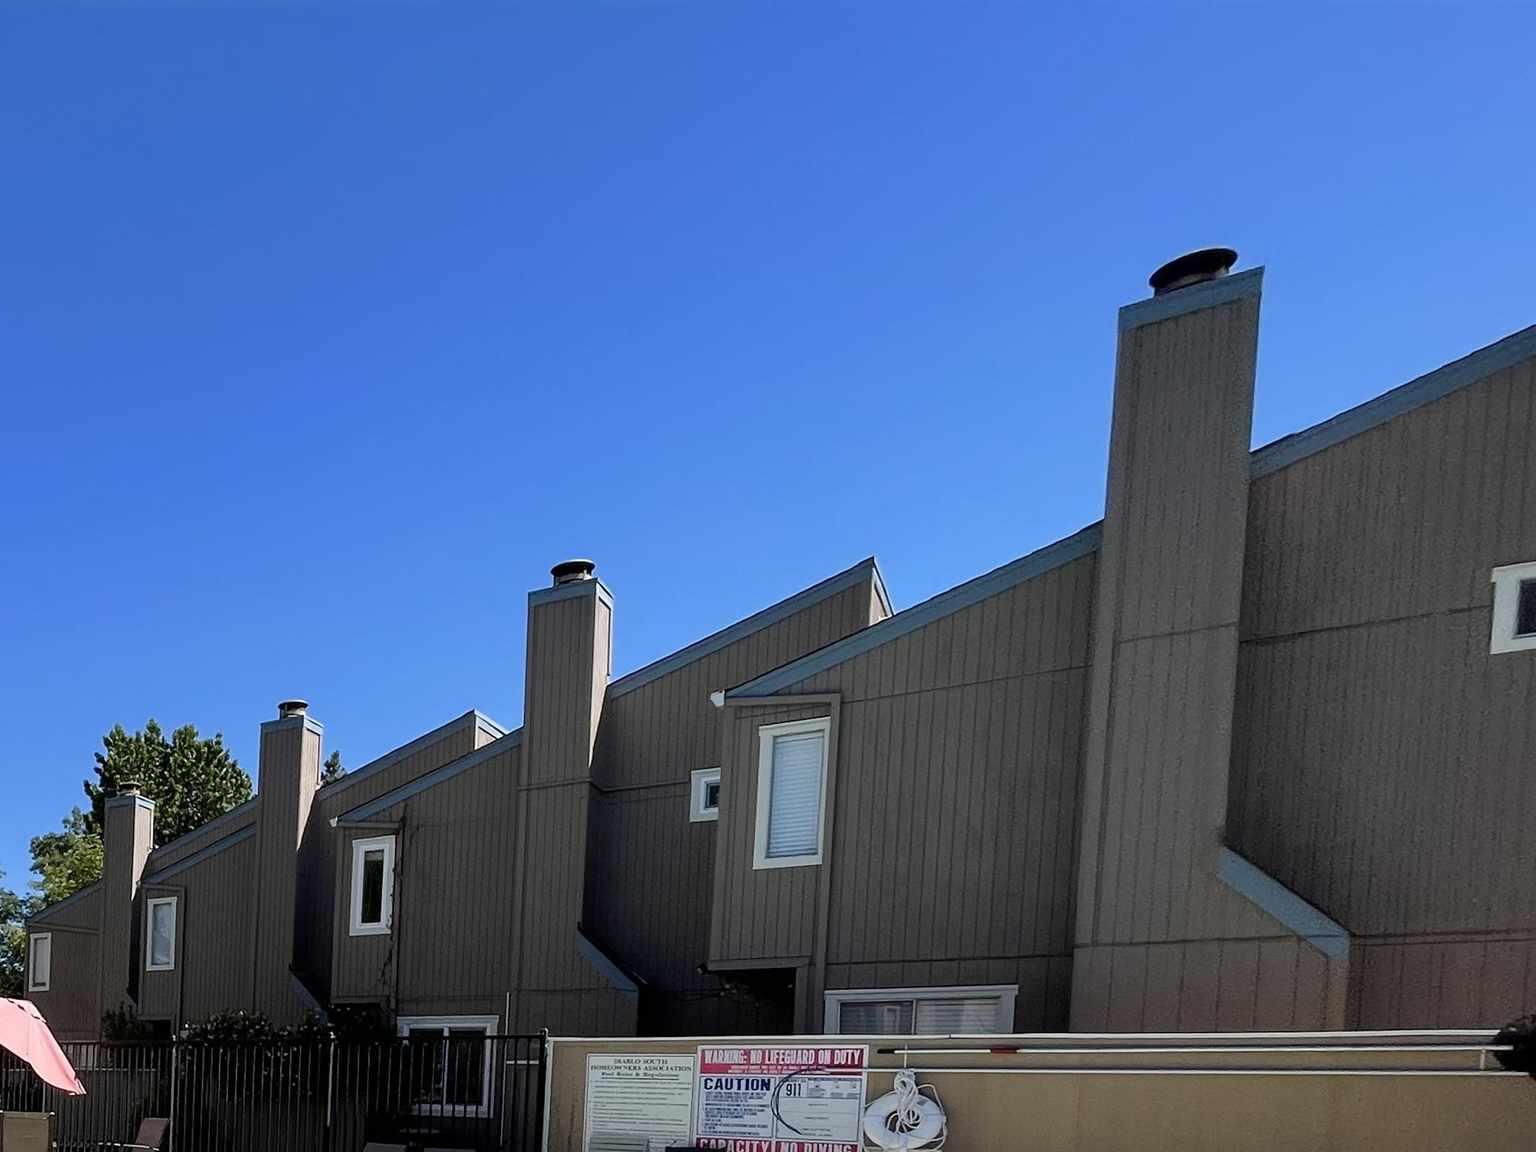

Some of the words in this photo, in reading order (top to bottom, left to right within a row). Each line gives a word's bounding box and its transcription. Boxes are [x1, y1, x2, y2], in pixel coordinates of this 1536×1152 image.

[704, 1049, 748, 1064] WARNING:
[750, 1050, 763, 1064] NO
[765, 1050, 815, 1065] LIFEGUARD
[817, 1050, 831, 1065] ON
[834, 1050, 861, 1065] DUTY
[704, 1077, 771, 1091] CAUTION
[786, 1083, 802, 1097] 911
